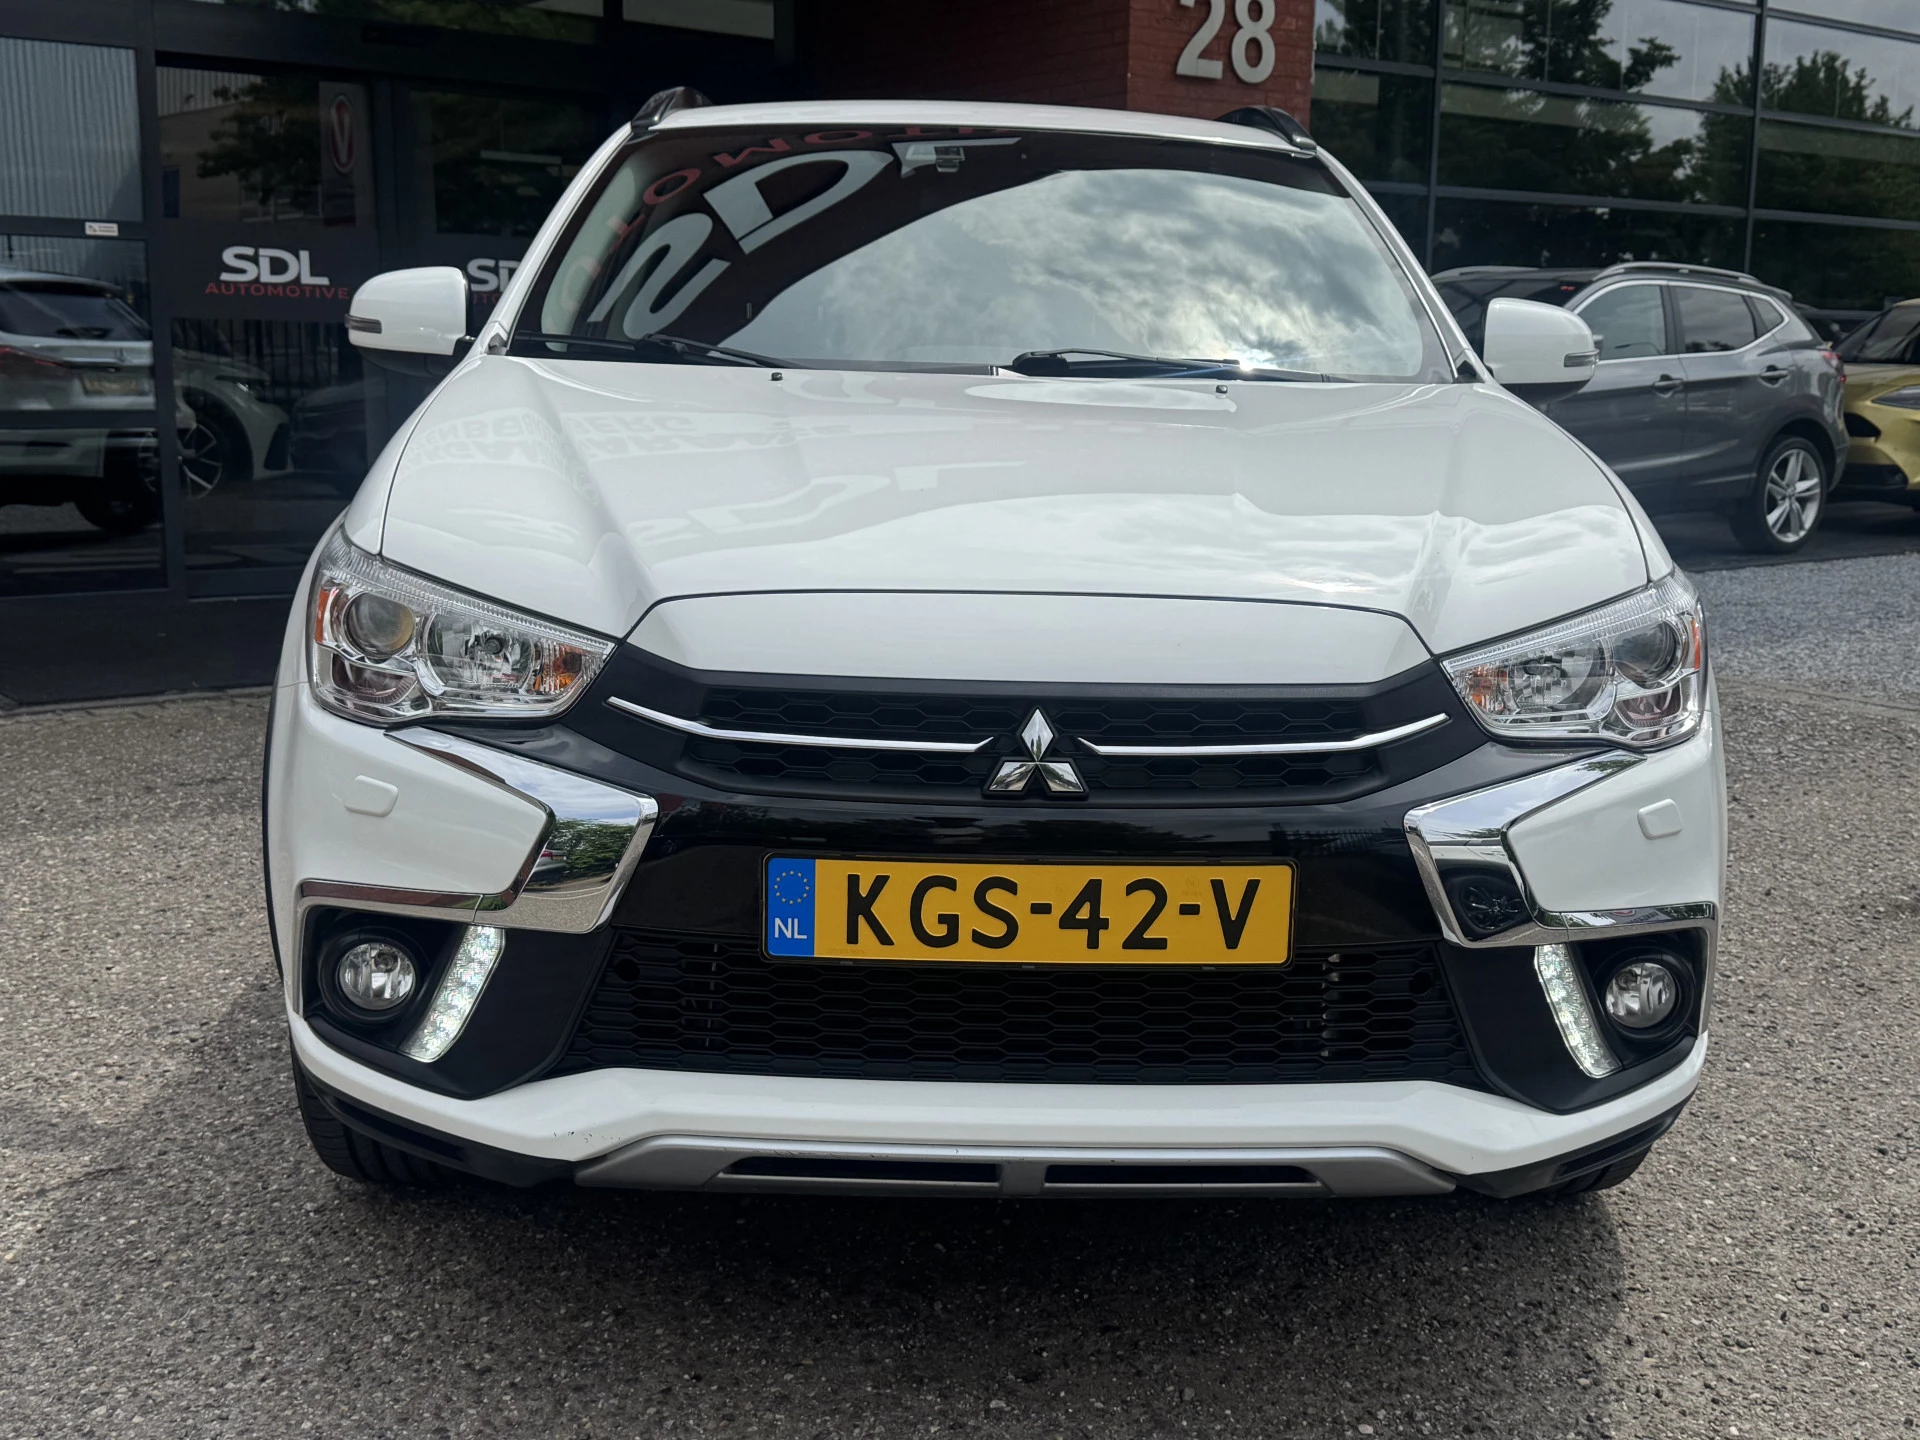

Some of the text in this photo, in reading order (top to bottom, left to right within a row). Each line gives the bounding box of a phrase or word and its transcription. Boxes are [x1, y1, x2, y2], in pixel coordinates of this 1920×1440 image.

[1176, 0, 1276, 83] 28
[219, 245, 330, 286] SDL
[467, 258, 522, 292] SD
[205, 282, 349, 300] AUTOMOTIVE
[774, 917, 808, 940] NL
[846, 873, 1261, 950] KGS-42-V
